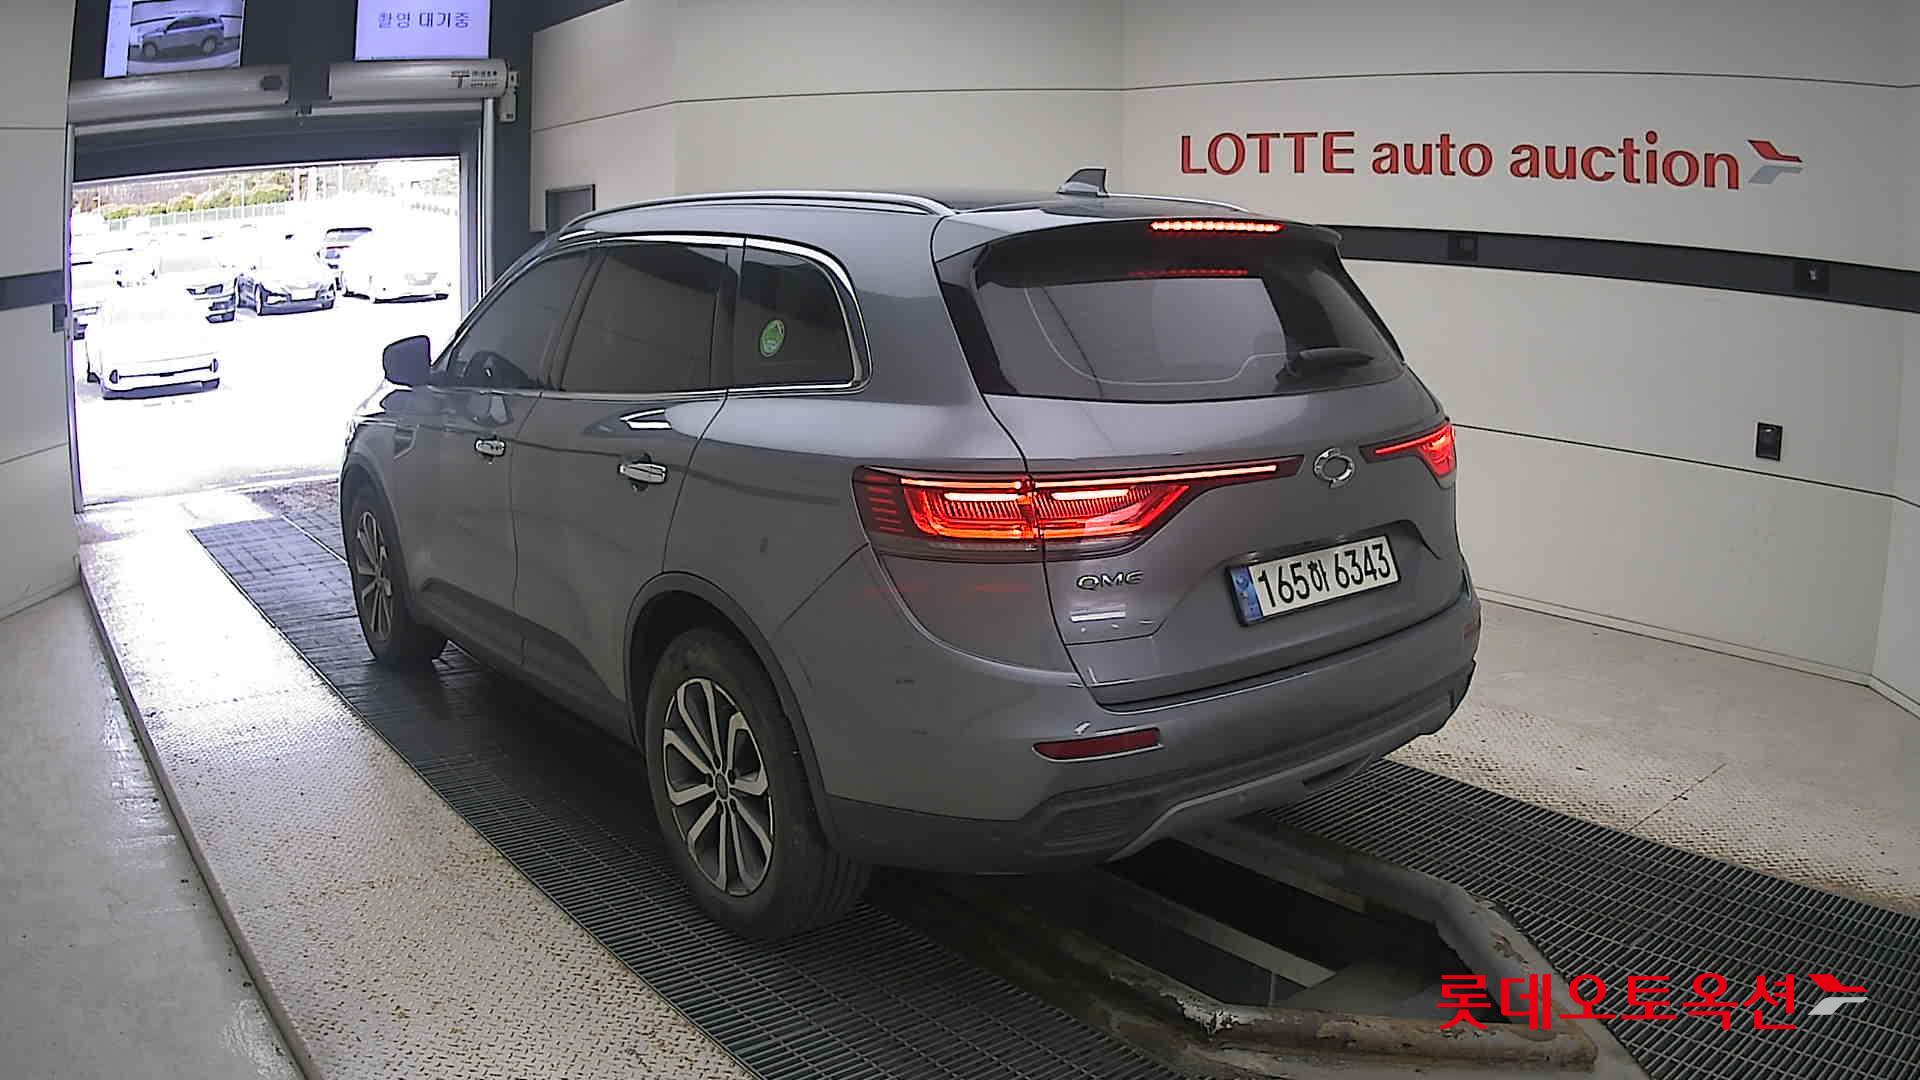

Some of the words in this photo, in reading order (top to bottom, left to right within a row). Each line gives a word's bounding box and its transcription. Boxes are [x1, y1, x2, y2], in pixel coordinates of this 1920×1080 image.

[419, 11, 472, 29] 대기중
[1180, 131, 1354, 175] LOTTE
[1371, 133, 1493, 177] auto
[1510, 130, 1740, 190] auction
[1258, 560, 1330, 608] 165하
[1334, 543, 1391, 589] 6343
